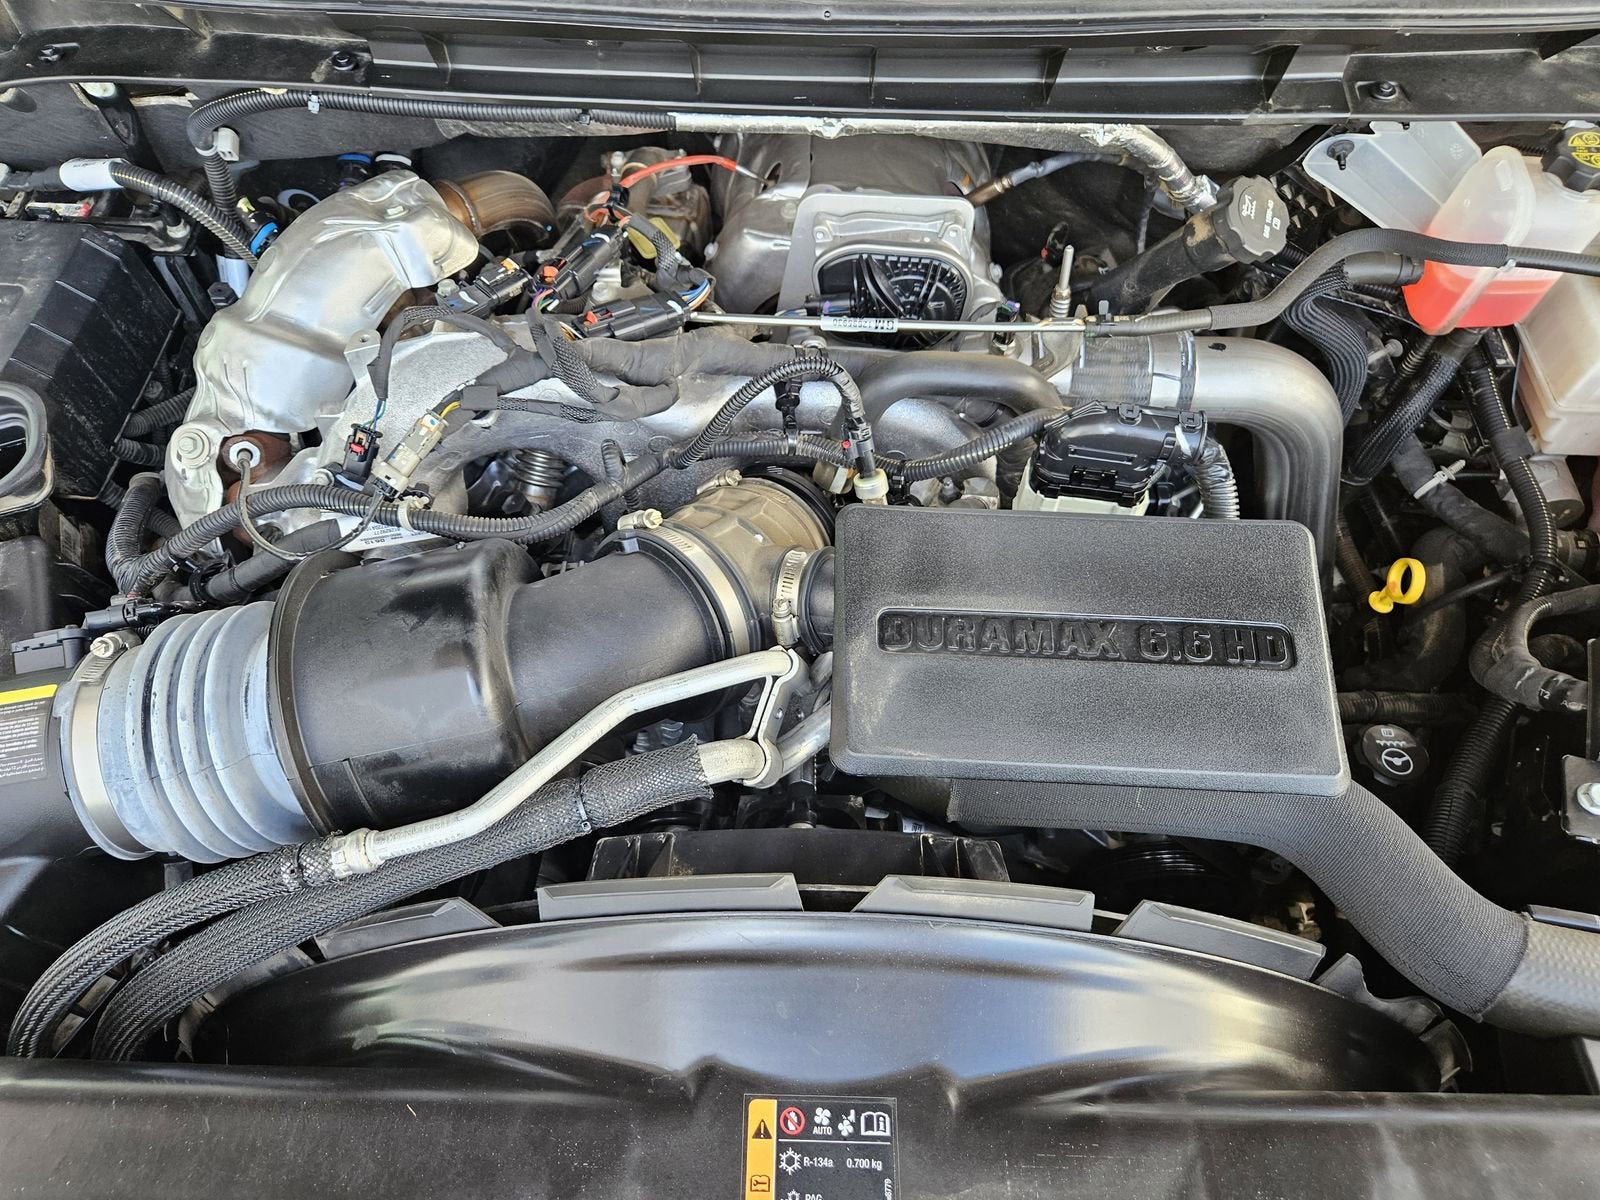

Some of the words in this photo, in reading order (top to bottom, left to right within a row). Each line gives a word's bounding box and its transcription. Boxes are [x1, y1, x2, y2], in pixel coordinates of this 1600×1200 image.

[882, 614, 1121, 658] DURAMAX
[1138, 622, 1214, 663] 6.6
[1222, 627, 1289, 665] HD
[812, 1126, 833, 1135] AUTO
[803, 1157, 834, 1168] R-134a
[846, 1158, 870, 1169] 0.700
[871, 1158, 883, 1171] kg
